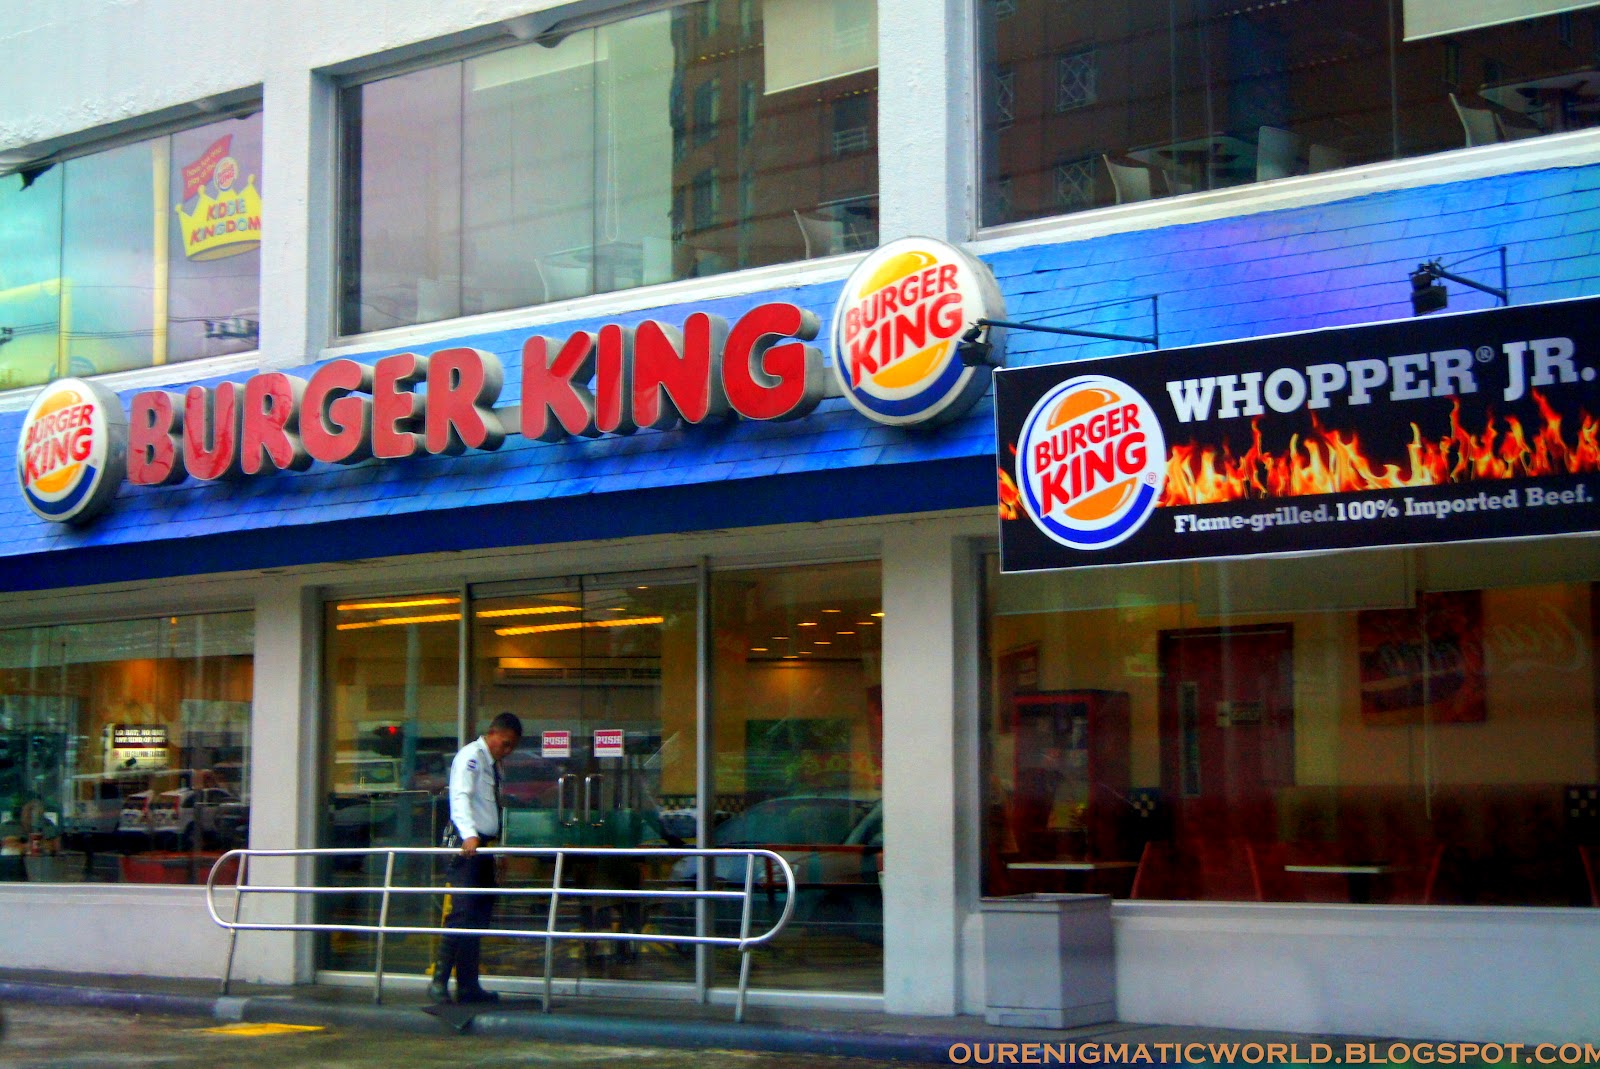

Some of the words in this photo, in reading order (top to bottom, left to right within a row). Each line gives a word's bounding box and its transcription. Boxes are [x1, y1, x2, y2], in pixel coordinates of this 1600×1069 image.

[190, 215, 261, 246] KINGDOM
[206, 198, 246, 221] KIDDIE
[844, 263, 958, 345] BURGER
[851, 292, 963, 391] KING
[1502, 336, 1597, 402] JR.
[127, 346, 488, 485] BURGER
[520, 302, 806, 439] KING
[24, 426, 93, 488] KING
[25, 404, 94, 451] BURGER
[1034, 403, 1140, 475] BURGER
[1040, 431, 1147, 518] KING
[1404, 489, 1519, 519] Imported
[1525, 483, 1594, 508] Beef.
[544, 736, 569, 746] PUSH
[595, 735, 622, 745] PUSH
